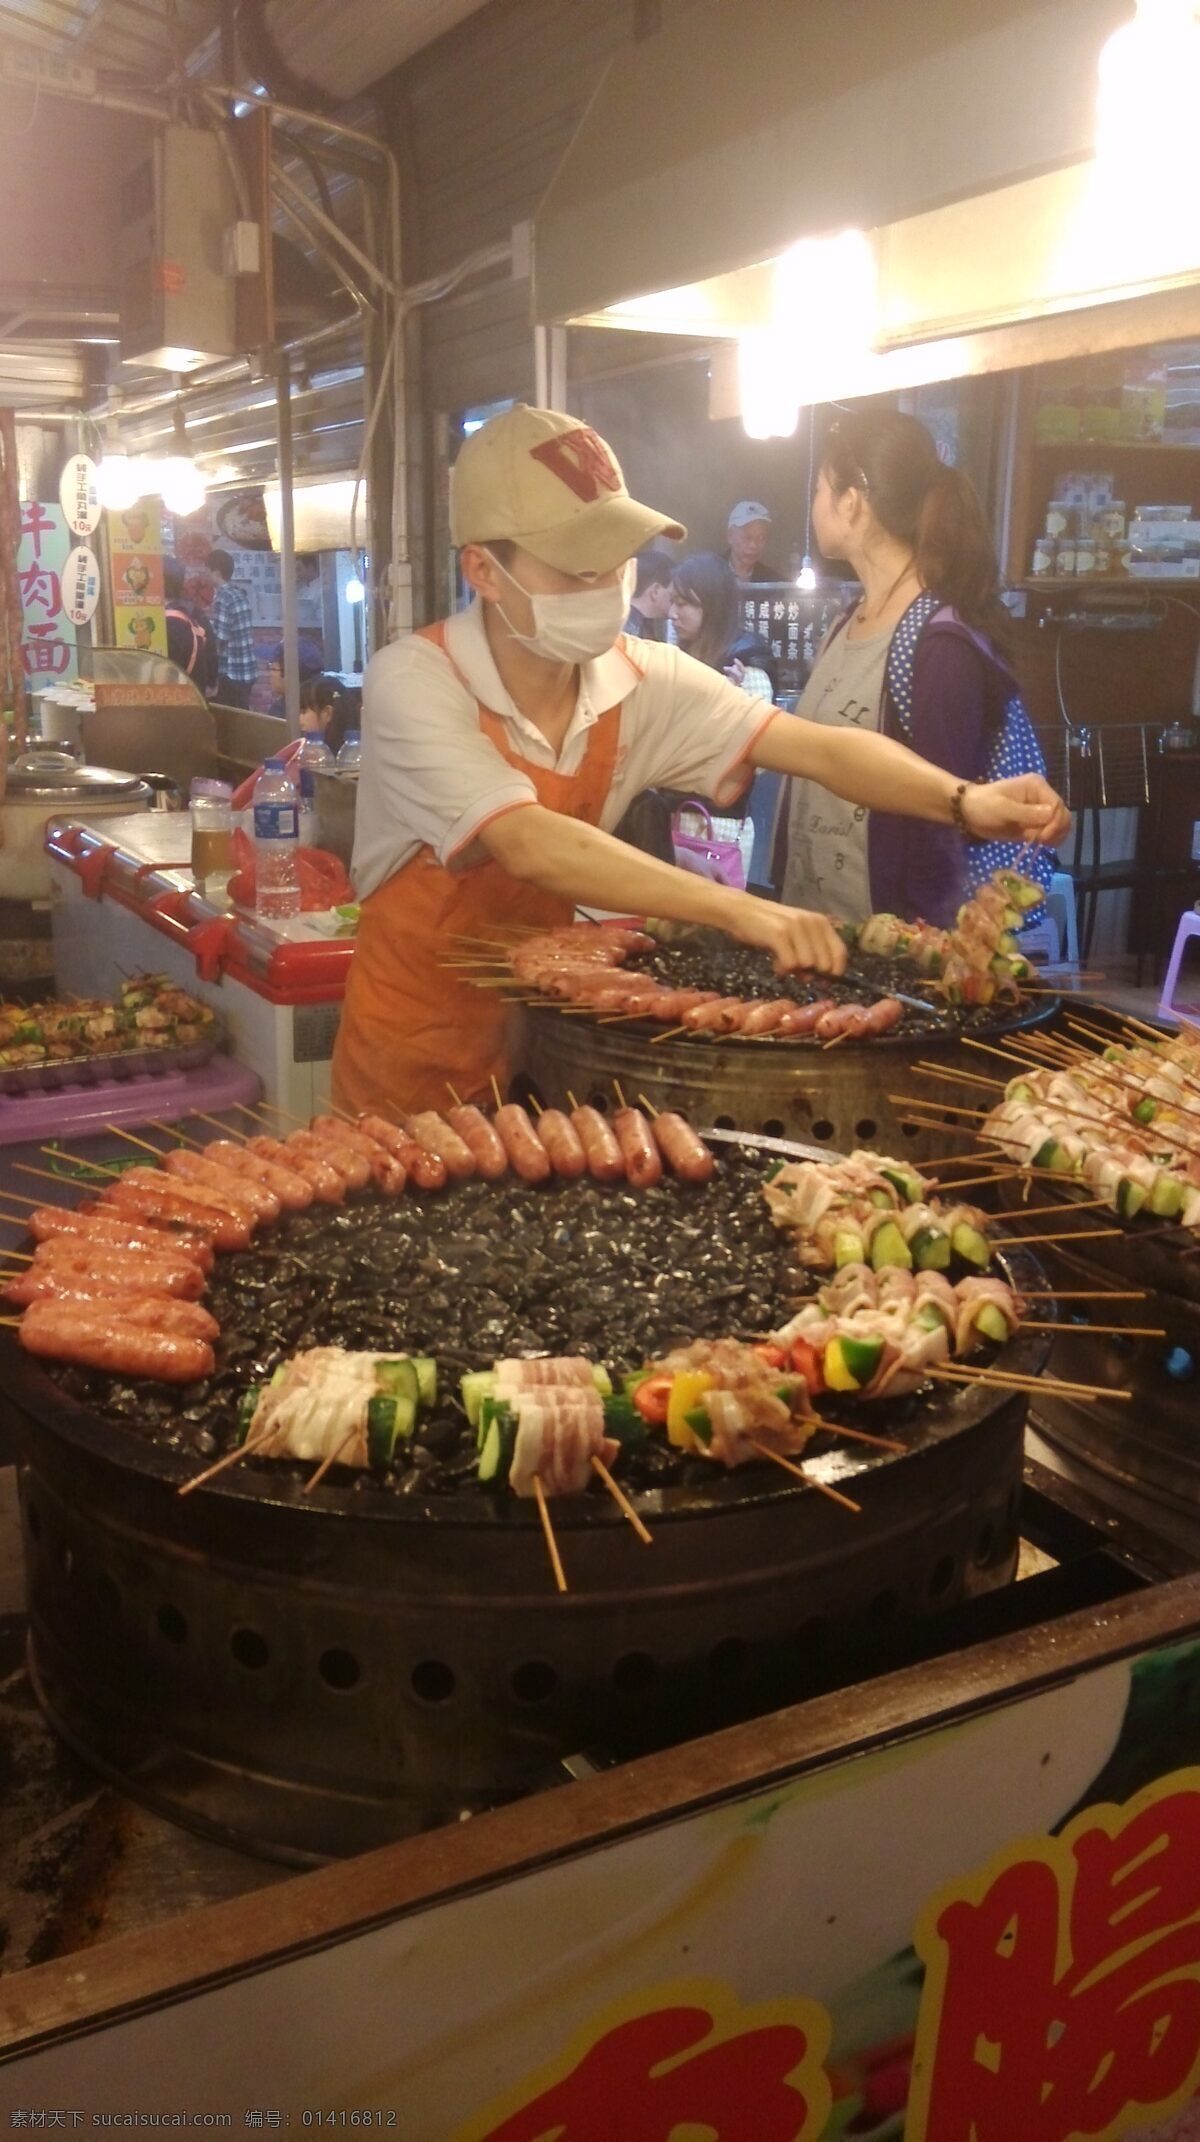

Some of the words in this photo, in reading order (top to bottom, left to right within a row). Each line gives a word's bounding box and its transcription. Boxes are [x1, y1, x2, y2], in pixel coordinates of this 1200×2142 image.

[529, 427, 622, 503] W
[18, 501, 71, 675] 牛肉面
